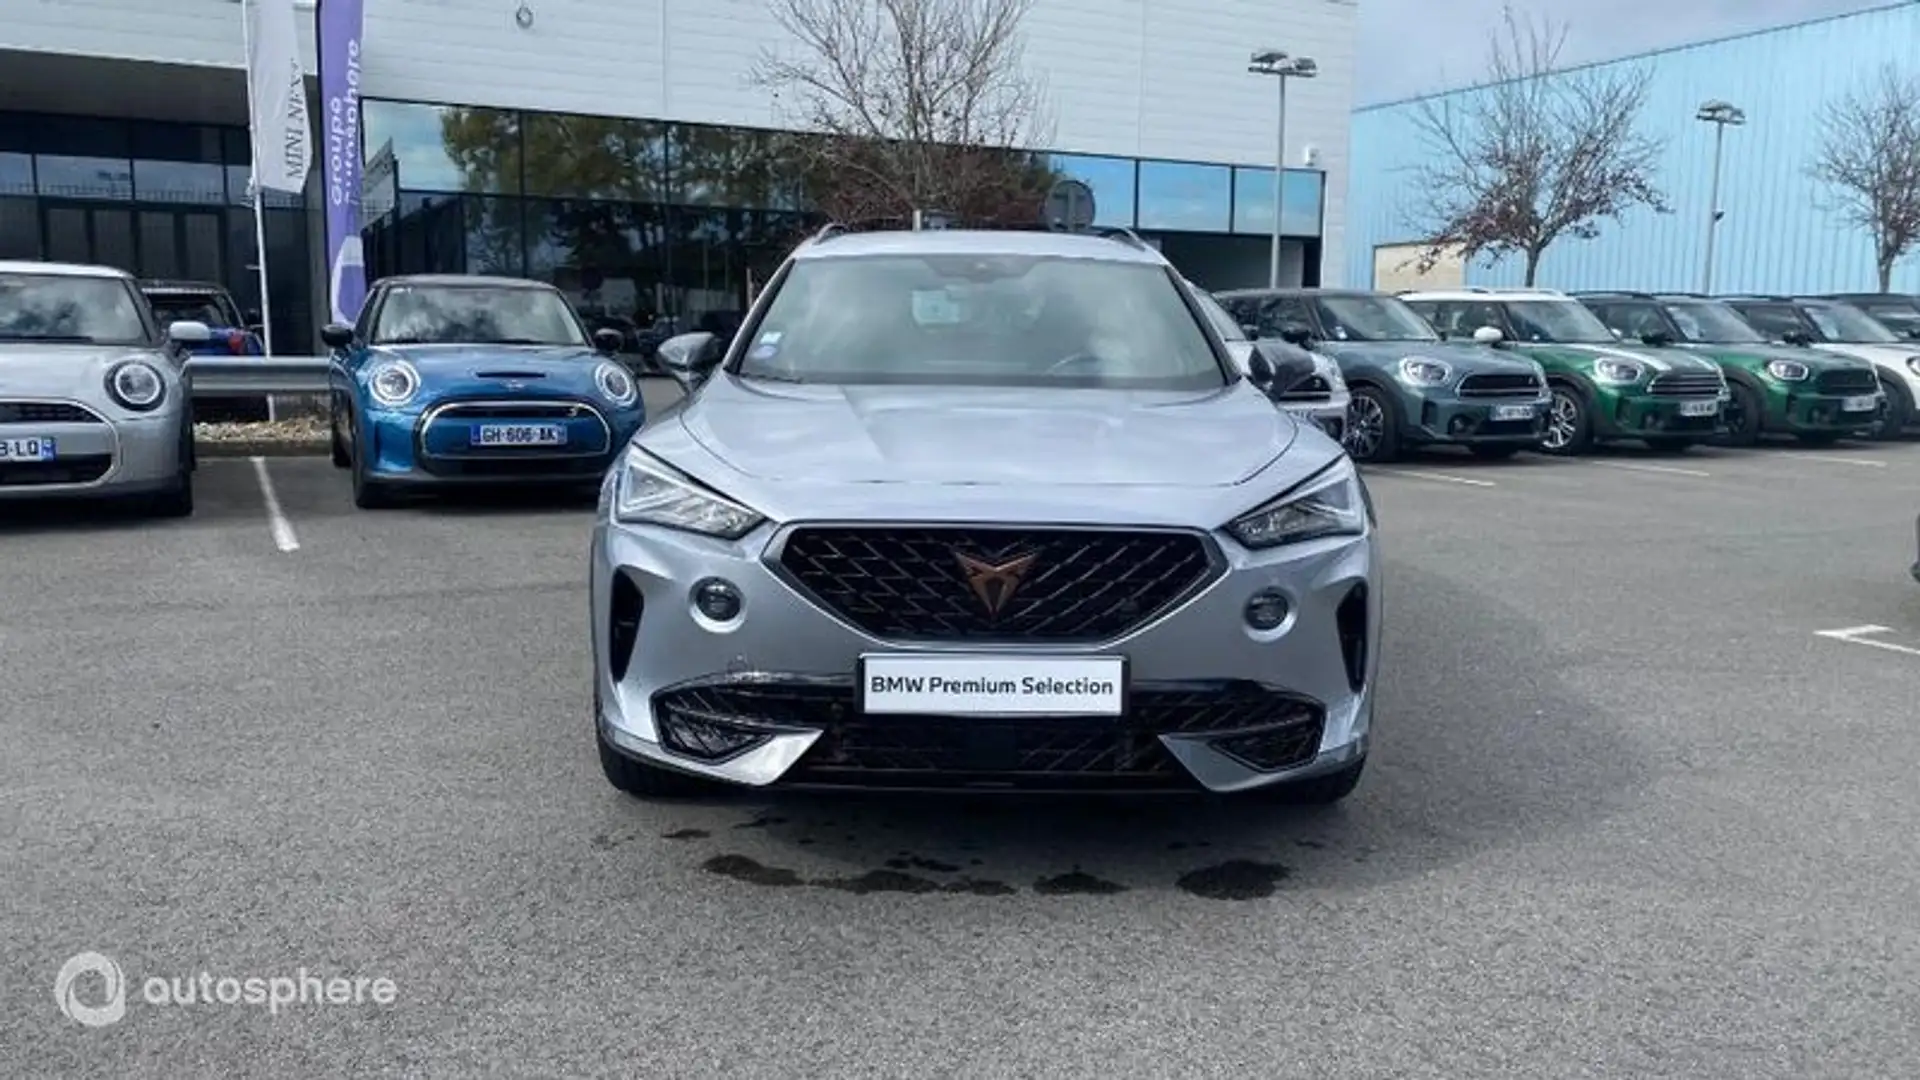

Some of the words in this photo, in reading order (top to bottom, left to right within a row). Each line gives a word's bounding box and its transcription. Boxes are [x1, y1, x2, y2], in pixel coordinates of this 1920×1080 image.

[284, 126, 304, 179] MINI
[329, 97, 345, 206] Groupe
[871, 676, 925, 693] BMW
[929, 677, 1016, 694] Premium
[1022, 677, 1113, 695] Selection
